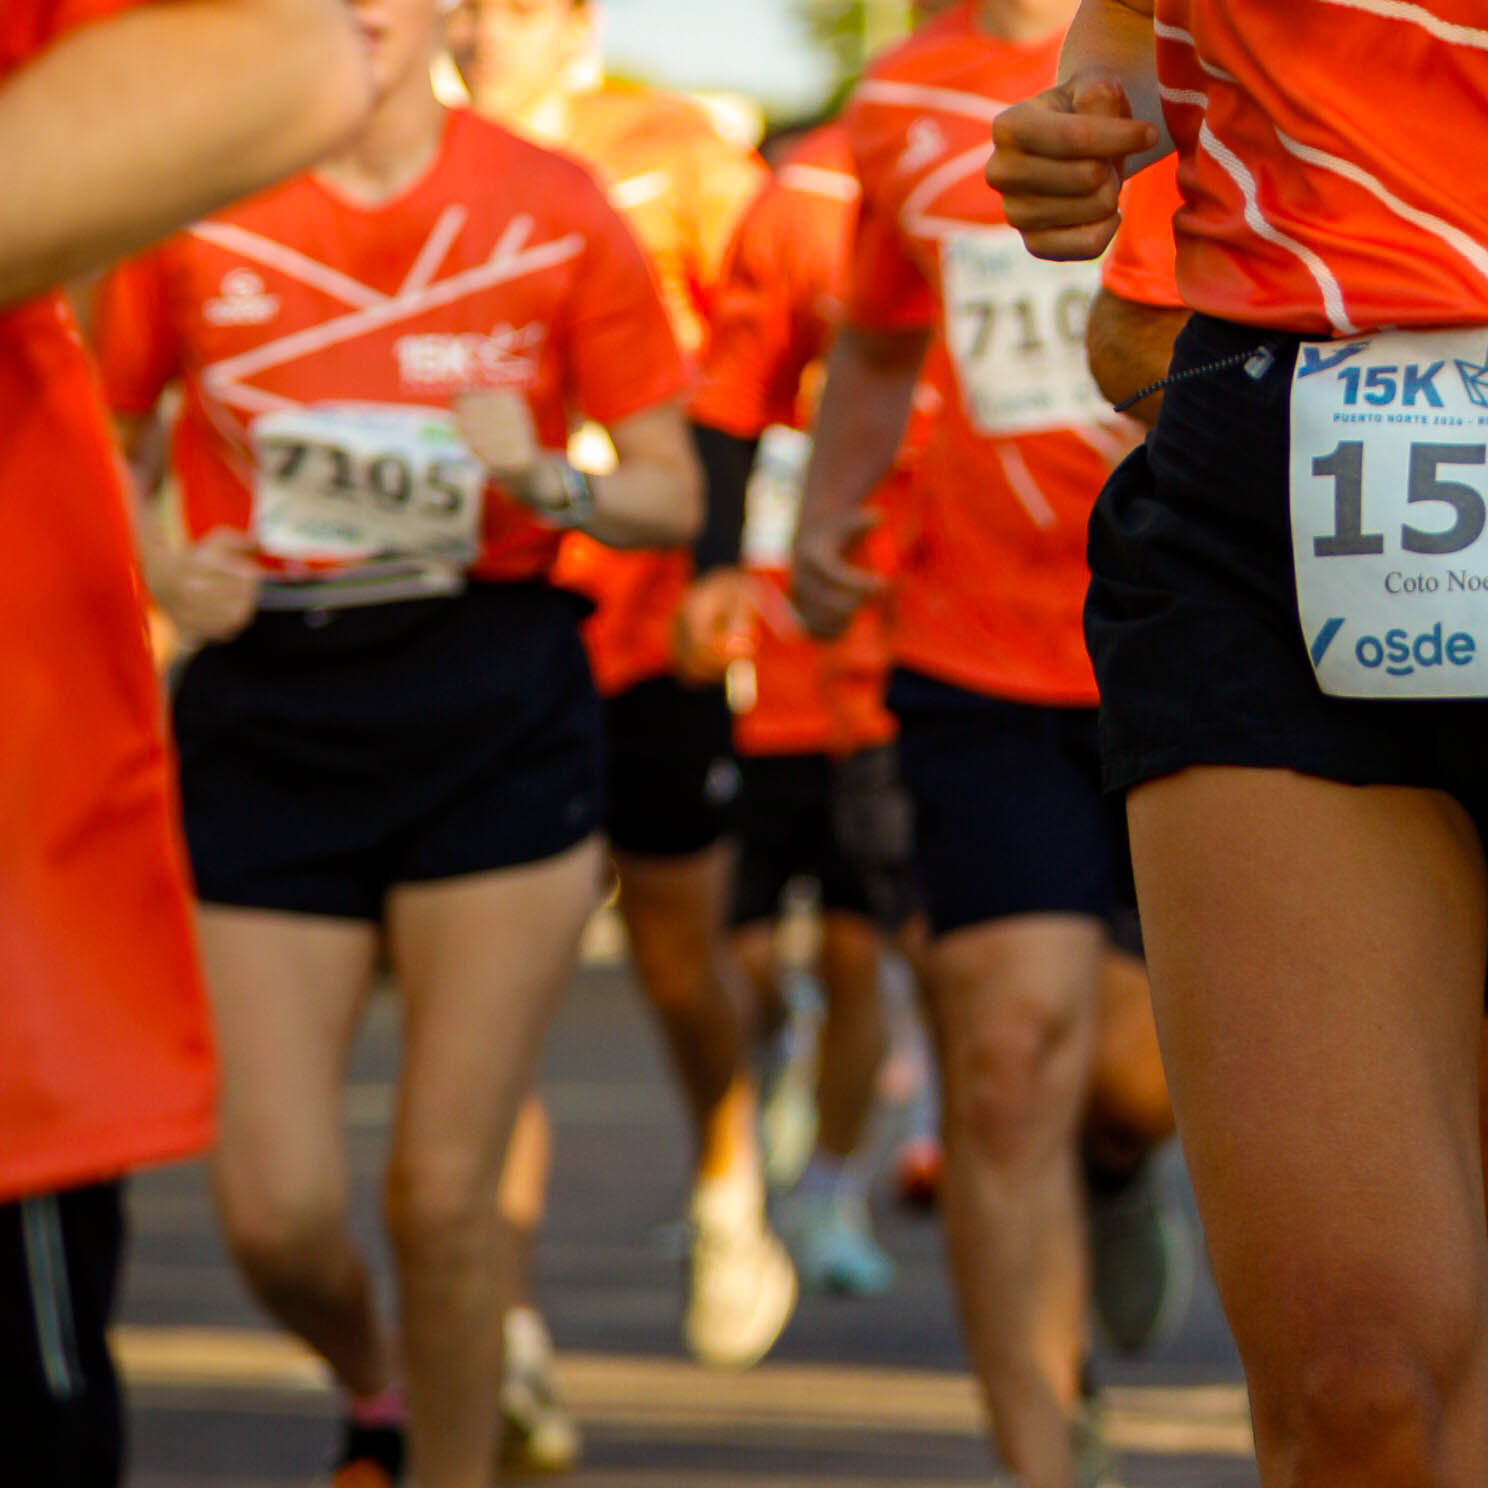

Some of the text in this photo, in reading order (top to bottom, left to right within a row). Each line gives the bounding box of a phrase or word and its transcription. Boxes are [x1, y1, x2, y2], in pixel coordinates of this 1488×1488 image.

[1336, 360, 1446, 408] 15K
[260, 432, 466, 516] 7105
[1384, 570, 1439, 594] Coto
[1354, 622, 1476, 671] osde
